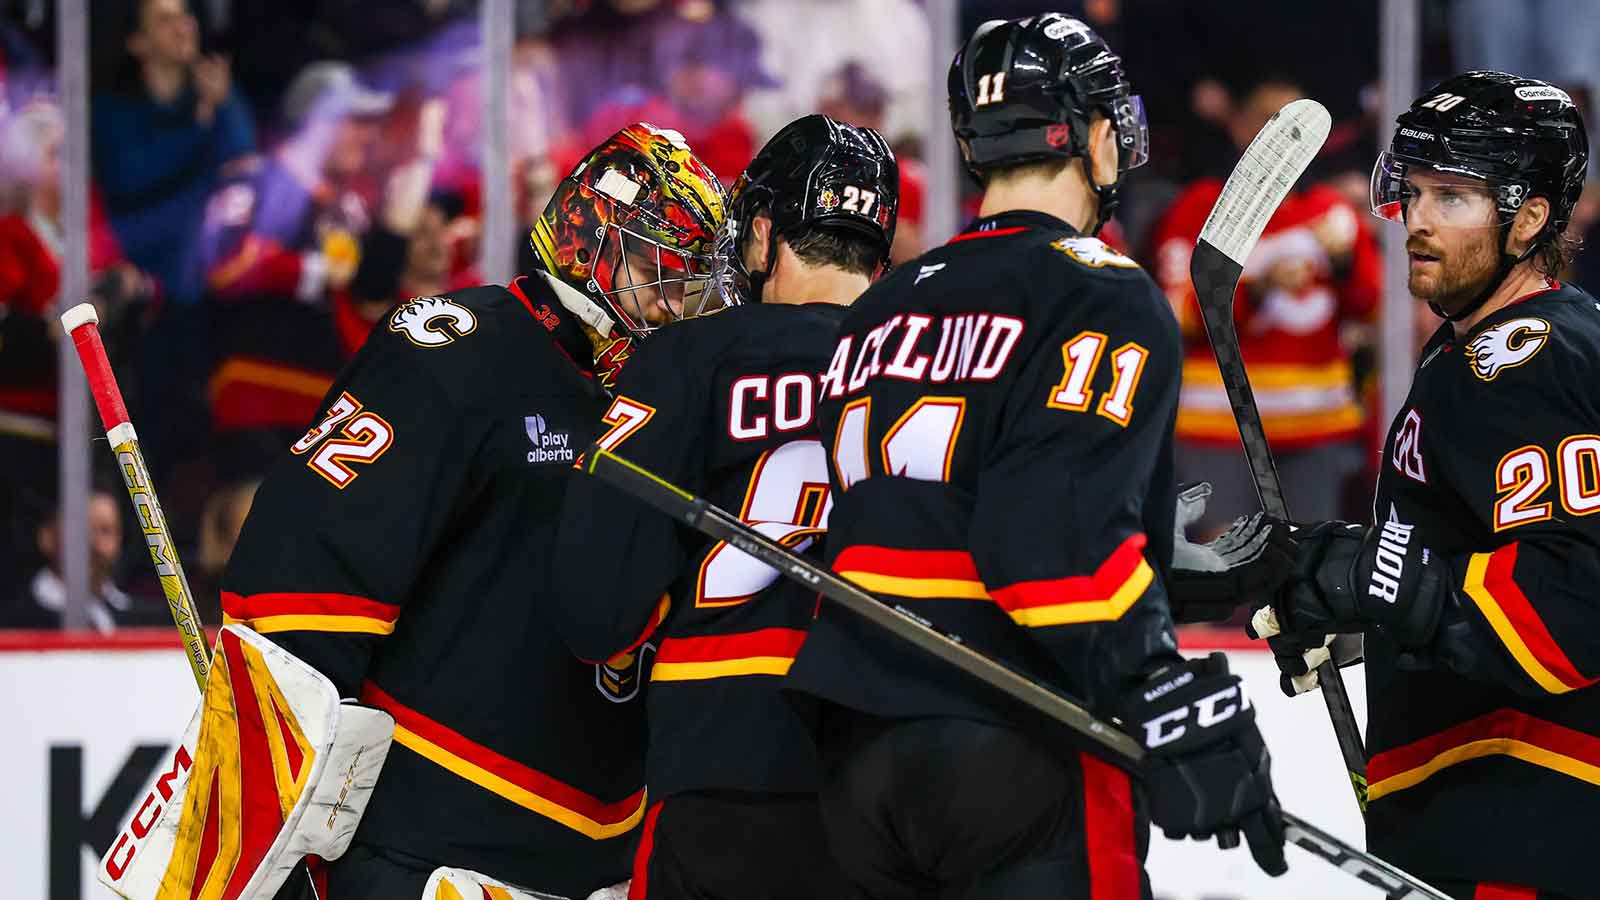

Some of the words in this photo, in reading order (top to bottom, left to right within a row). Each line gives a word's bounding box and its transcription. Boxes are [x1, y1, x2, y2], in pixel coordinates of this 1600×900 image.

[975, 72, 1006, 107] 11
[1421, 93, 1466, 113] 20
[842, 185, 876, 216] 27
[535, 304, 561, 331] 32
[1047, 330, 1149, 427] 11
[291, 391, 395, 489] 32
[527, 449, 573, 463] alberta
[542, 432, 568, 448] play
[1494, 434, 1600, 533] 20
[117, 451, 177, 577] CCM
[168, 591, 197, 637] XF
[189, 638, 208, 676] PRO
[105, 744, 193, 882] CCM
[1284, 820, 1455, 900] CC
